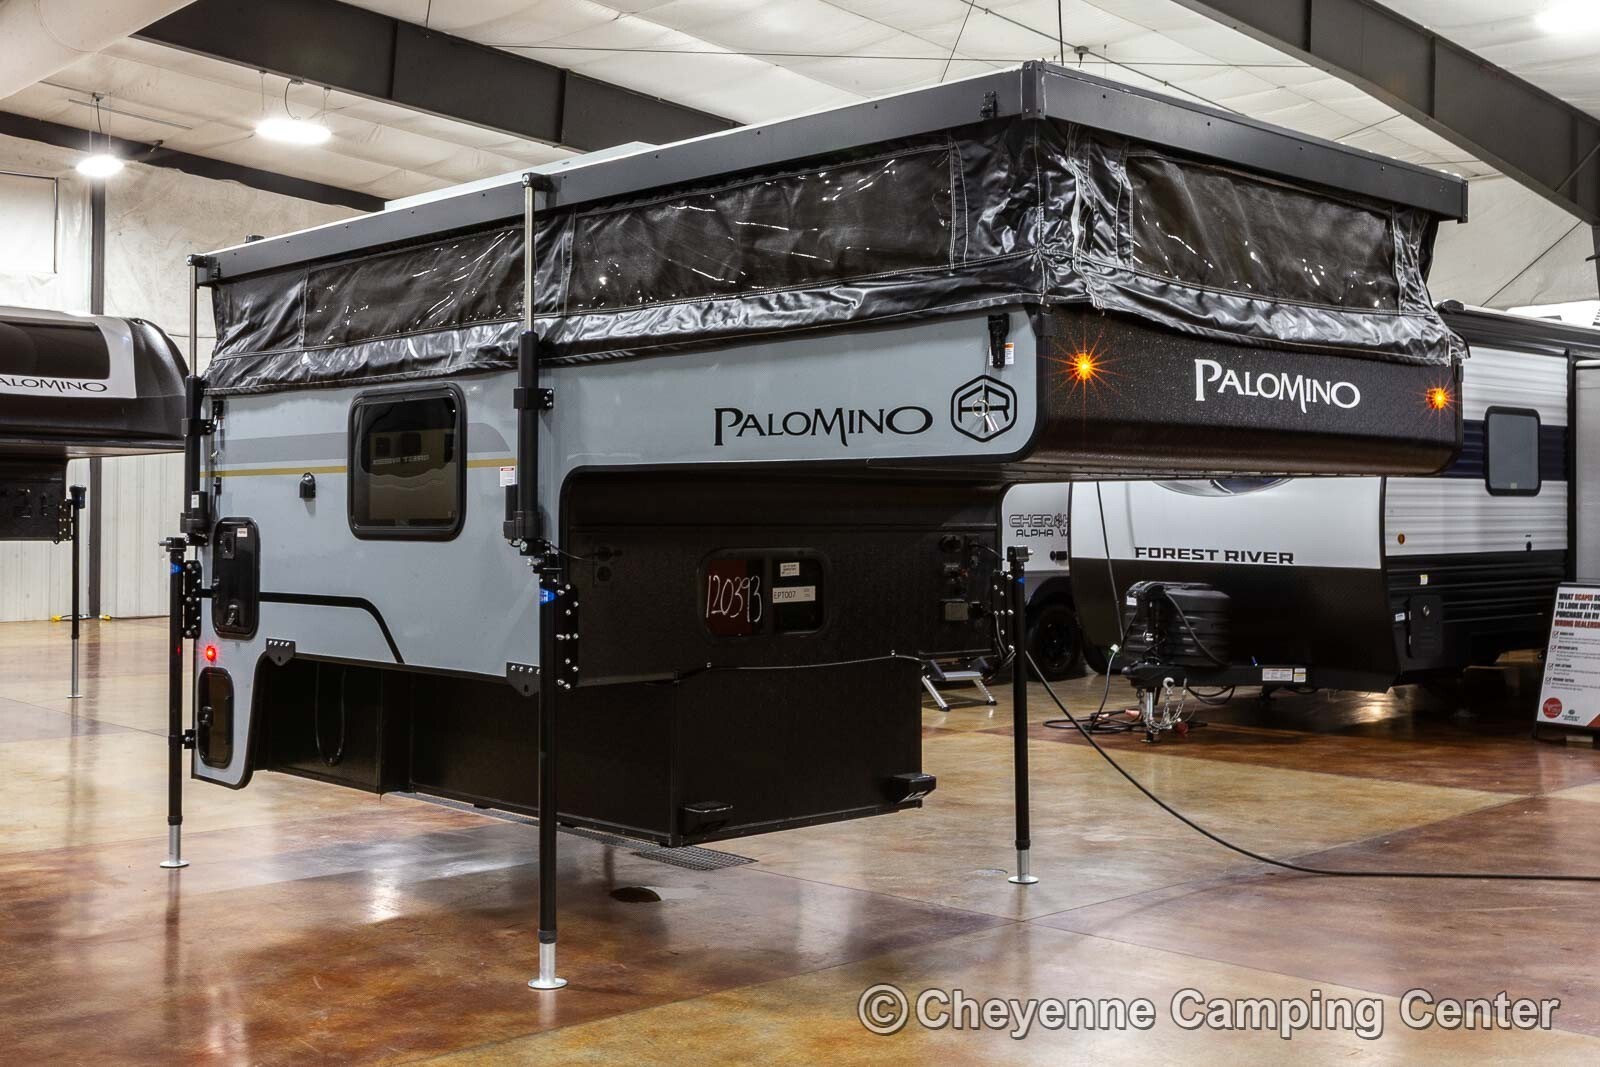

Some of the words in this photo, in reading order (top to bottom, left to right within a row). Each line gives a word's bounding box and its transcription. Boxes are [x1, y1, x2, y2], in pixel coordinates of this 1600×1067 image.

[1194, 358, 1361, 414] PALOMINO
[714, 405, 934, 448] PALOMINO
[1016, 528, 1054, 537] ALPHA
[1134, 546, 1219, 561] FOREST
[1224, 549, 1294, 565] RIVER
[705, 575, 762, 622] 120393
[1580, 602, 1590, 610] OUT
[1556, 610, 1583, 618] PURCHASE
[1592, 612, 1599, 620] RV
